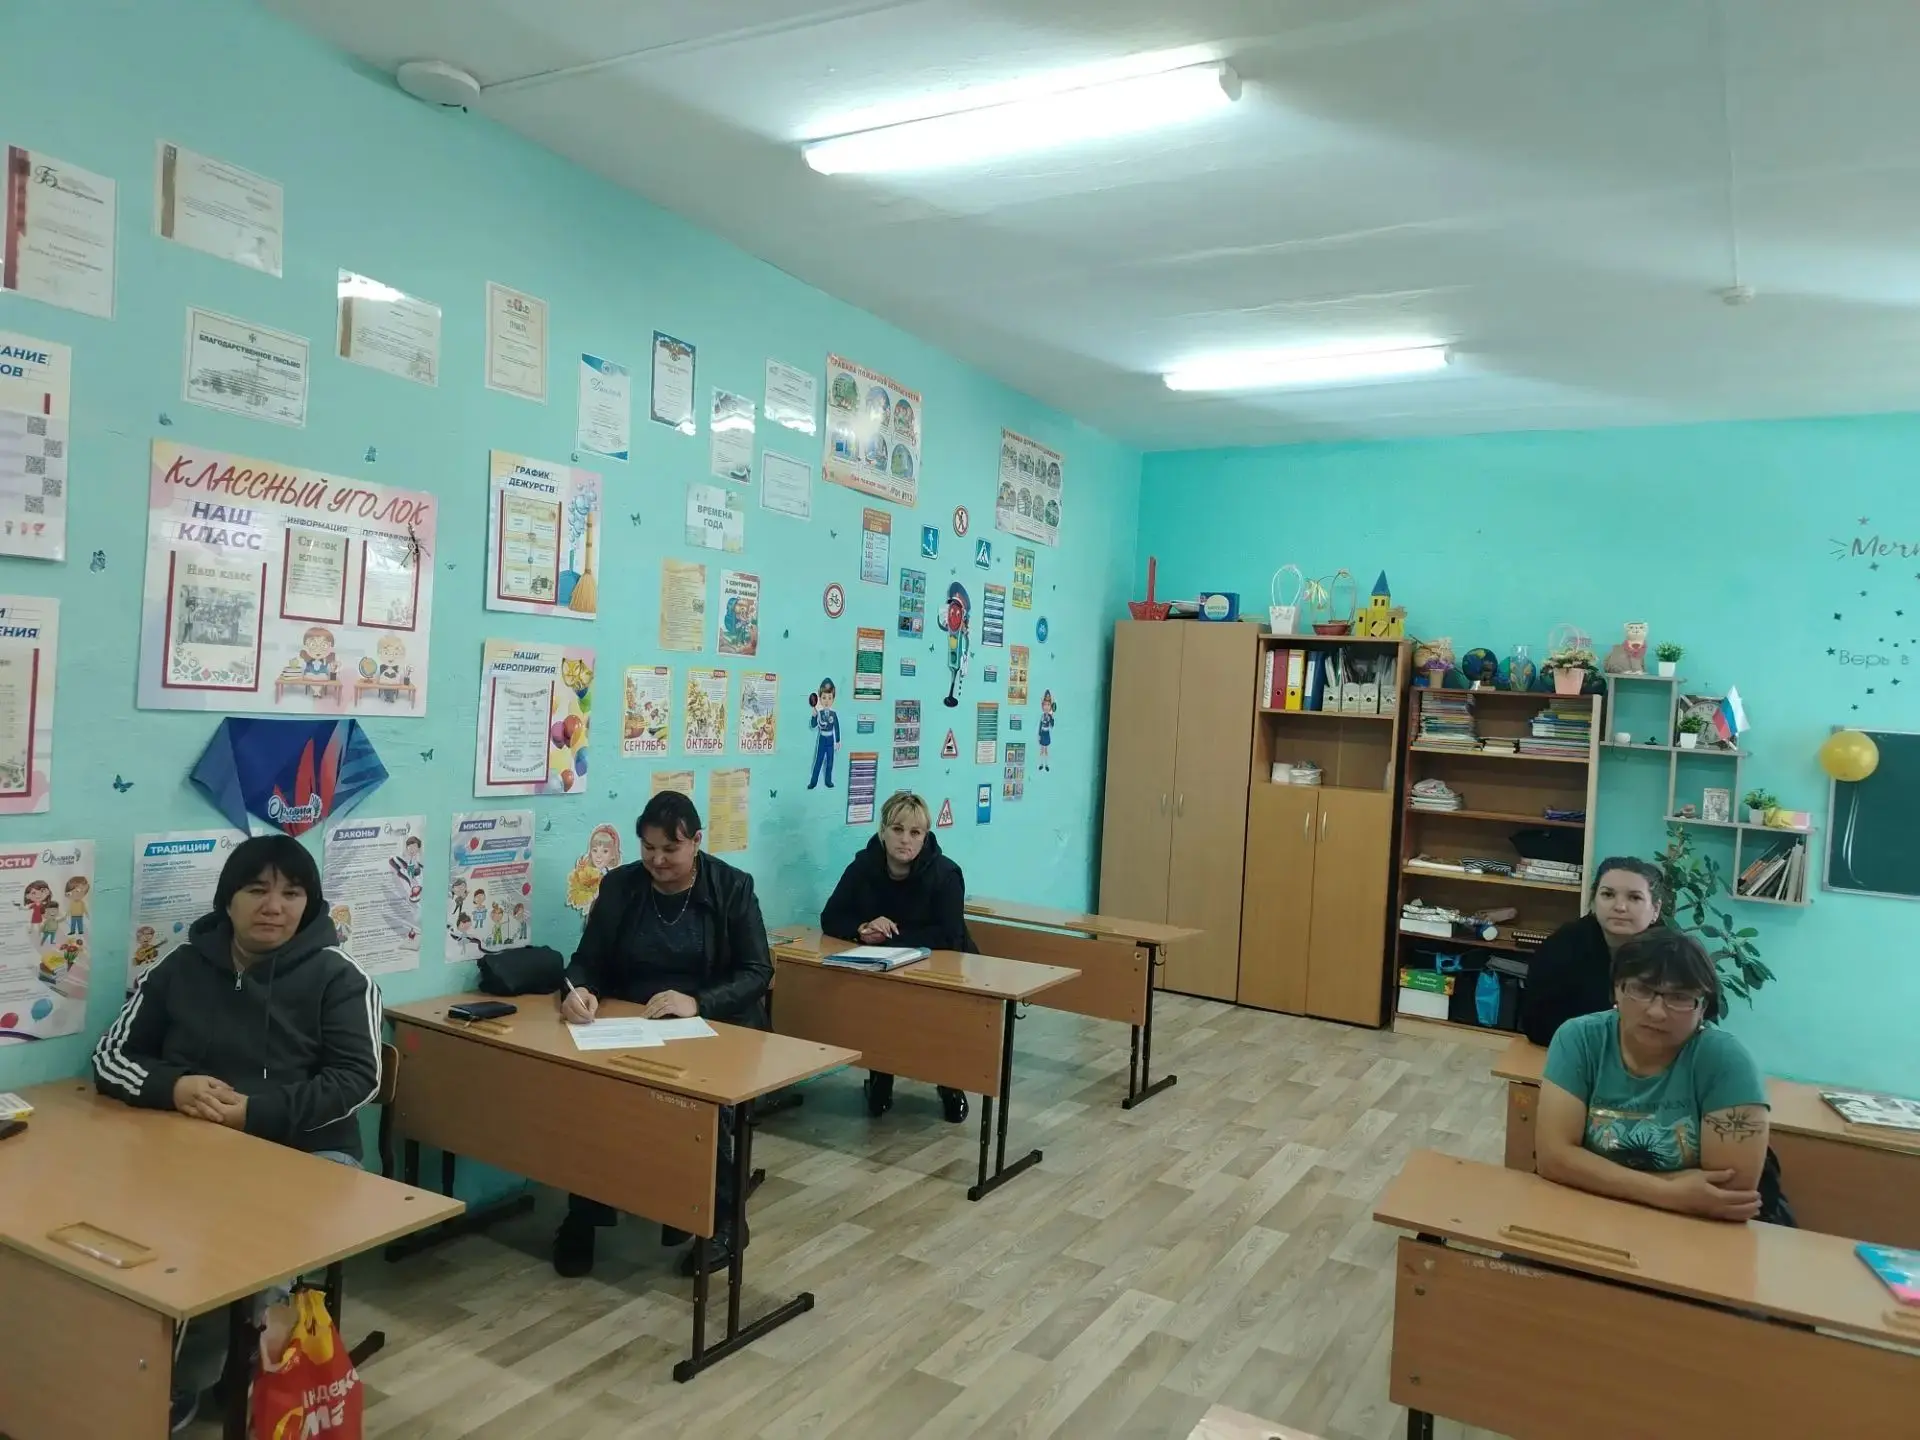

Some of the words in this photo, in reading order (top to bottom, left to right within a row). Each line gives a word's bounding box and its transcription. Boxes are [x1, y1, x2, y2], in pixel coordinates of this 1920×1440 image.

[0, 345, 48, 364] АНИЕ
[199, 333, 272, 361] БЛАГОДАРСТВЕННОЕ
[273, 355, 301, 369] ПИСЬМО
[0, 363, 23, 377] ОВ
[515, 465, 551, 480] ГРАФИК
[164, 455, 328, 509] КЛАССНЫЙ
[327, 487, 430, 526] УГОЛОК
[508, 477, 555, 494] ДЕЖУРСТВ
[191, 501, 252, 526] НАШ
[697, 505, 733, 520] ВРЕМЕНА
[287, 516, 348, 532] ИНФОРМАЦИЯ
[703, 518, 724, 530] ГОДА
[178, 523, 262, 550] КЛАСС
[187, 563, 215, 577] Наш
[219, 570, 253, 581] класс
[513, 651, 541, 660] НАШИ
[1840, 650, 1889, 668] Верь
[1901, 655, 1909, 665] в
[492, 663, 556, 674] МЕРОПРИЯТИЯ
[624, 739, 667, 751] СЕНТЯБРЬ
[686, 738, 723, 750] ОКТЯБРЬ
[741, 738, 773, 750] НОЯБРЬ
[463, 822, 492, 830] МИССИИ
[338, 829, 376, 839] ЗАКОНЫ
[150, 842, 210, 855] ТРАДИЦИИ
